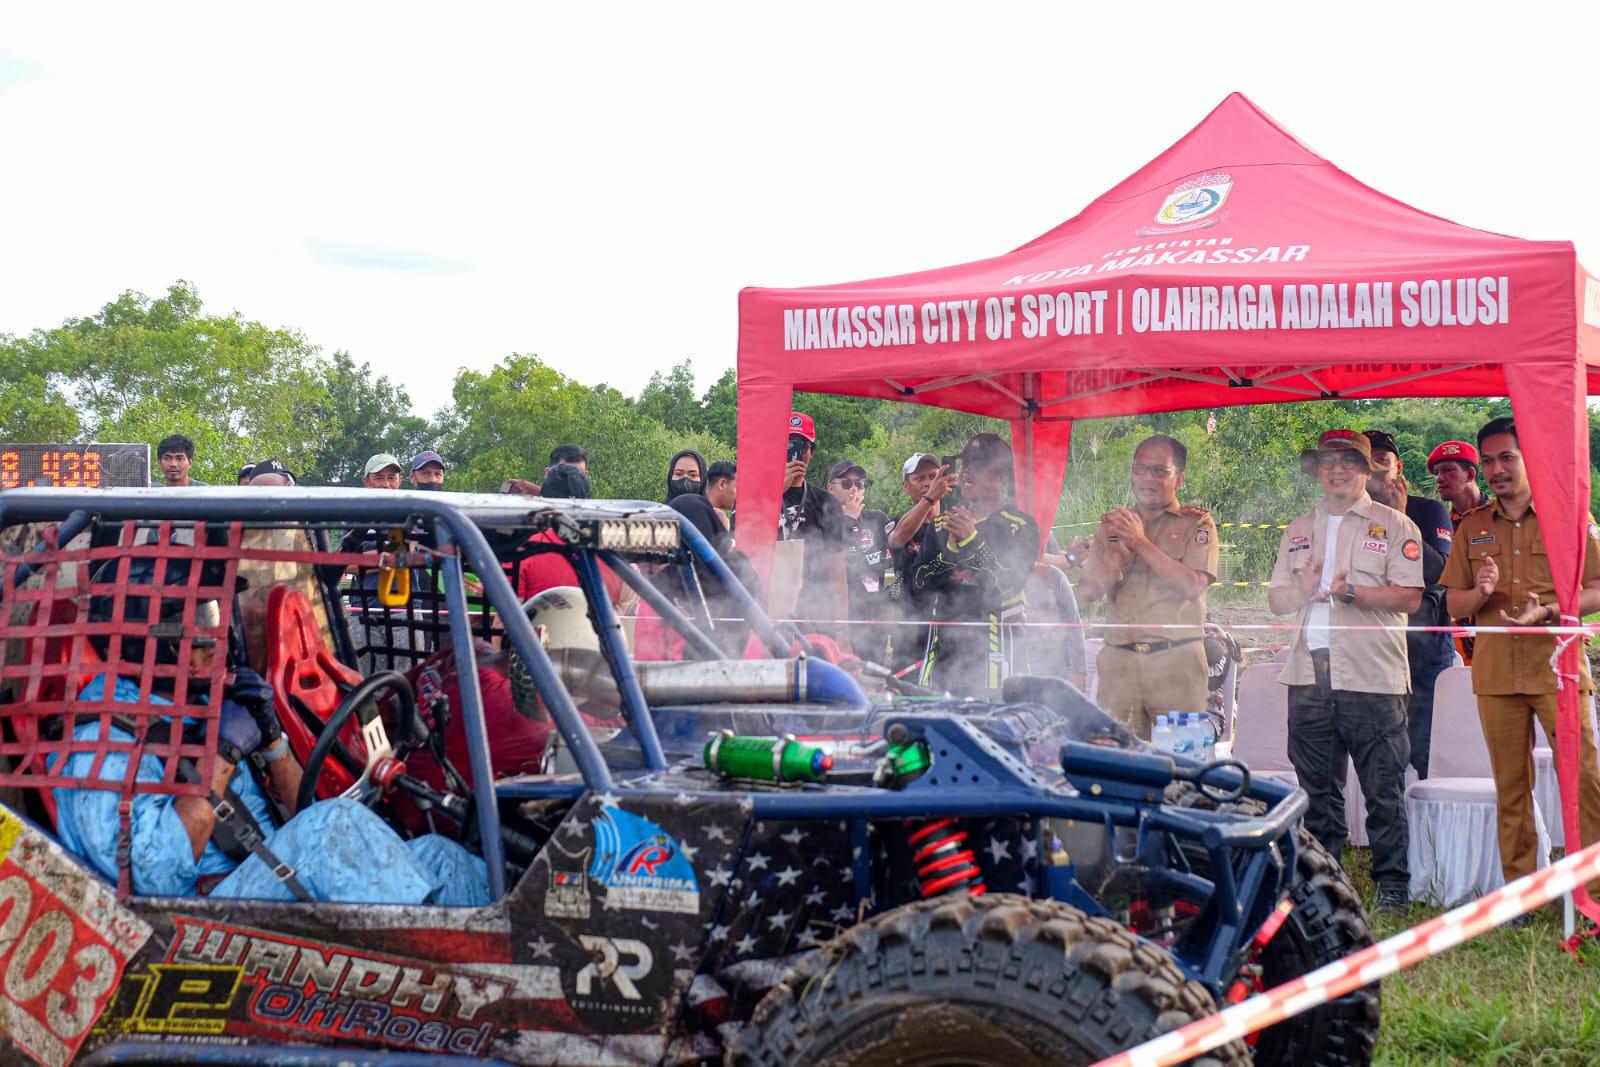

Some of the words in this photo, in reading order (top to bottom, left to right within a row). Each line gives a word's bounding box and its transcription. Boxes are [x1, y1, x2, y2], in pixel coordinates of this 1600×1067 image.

[1002, 263, 1094, 287] KOTA
[1096, 245, 1311, 273] MAKASSAR
[1101, 237, 1234, 259] PEMERINTAH
[783, 304, 917, 351] MAKASSAR
[920, 299, 978, 344] CITY
[984, 296, 1016, 341] OF
[1021, 290, 1108, 339] SPORT
[1131, 284, 1277, 334] OLAHRAGA
[1281, 281, 1393, 330] ADALAH
[1400, 276, 1509, 328] SOLUSI
[611, 873, 697, 891] UNIPRIMA
[172, 923, 511, 1021] WANDHY
